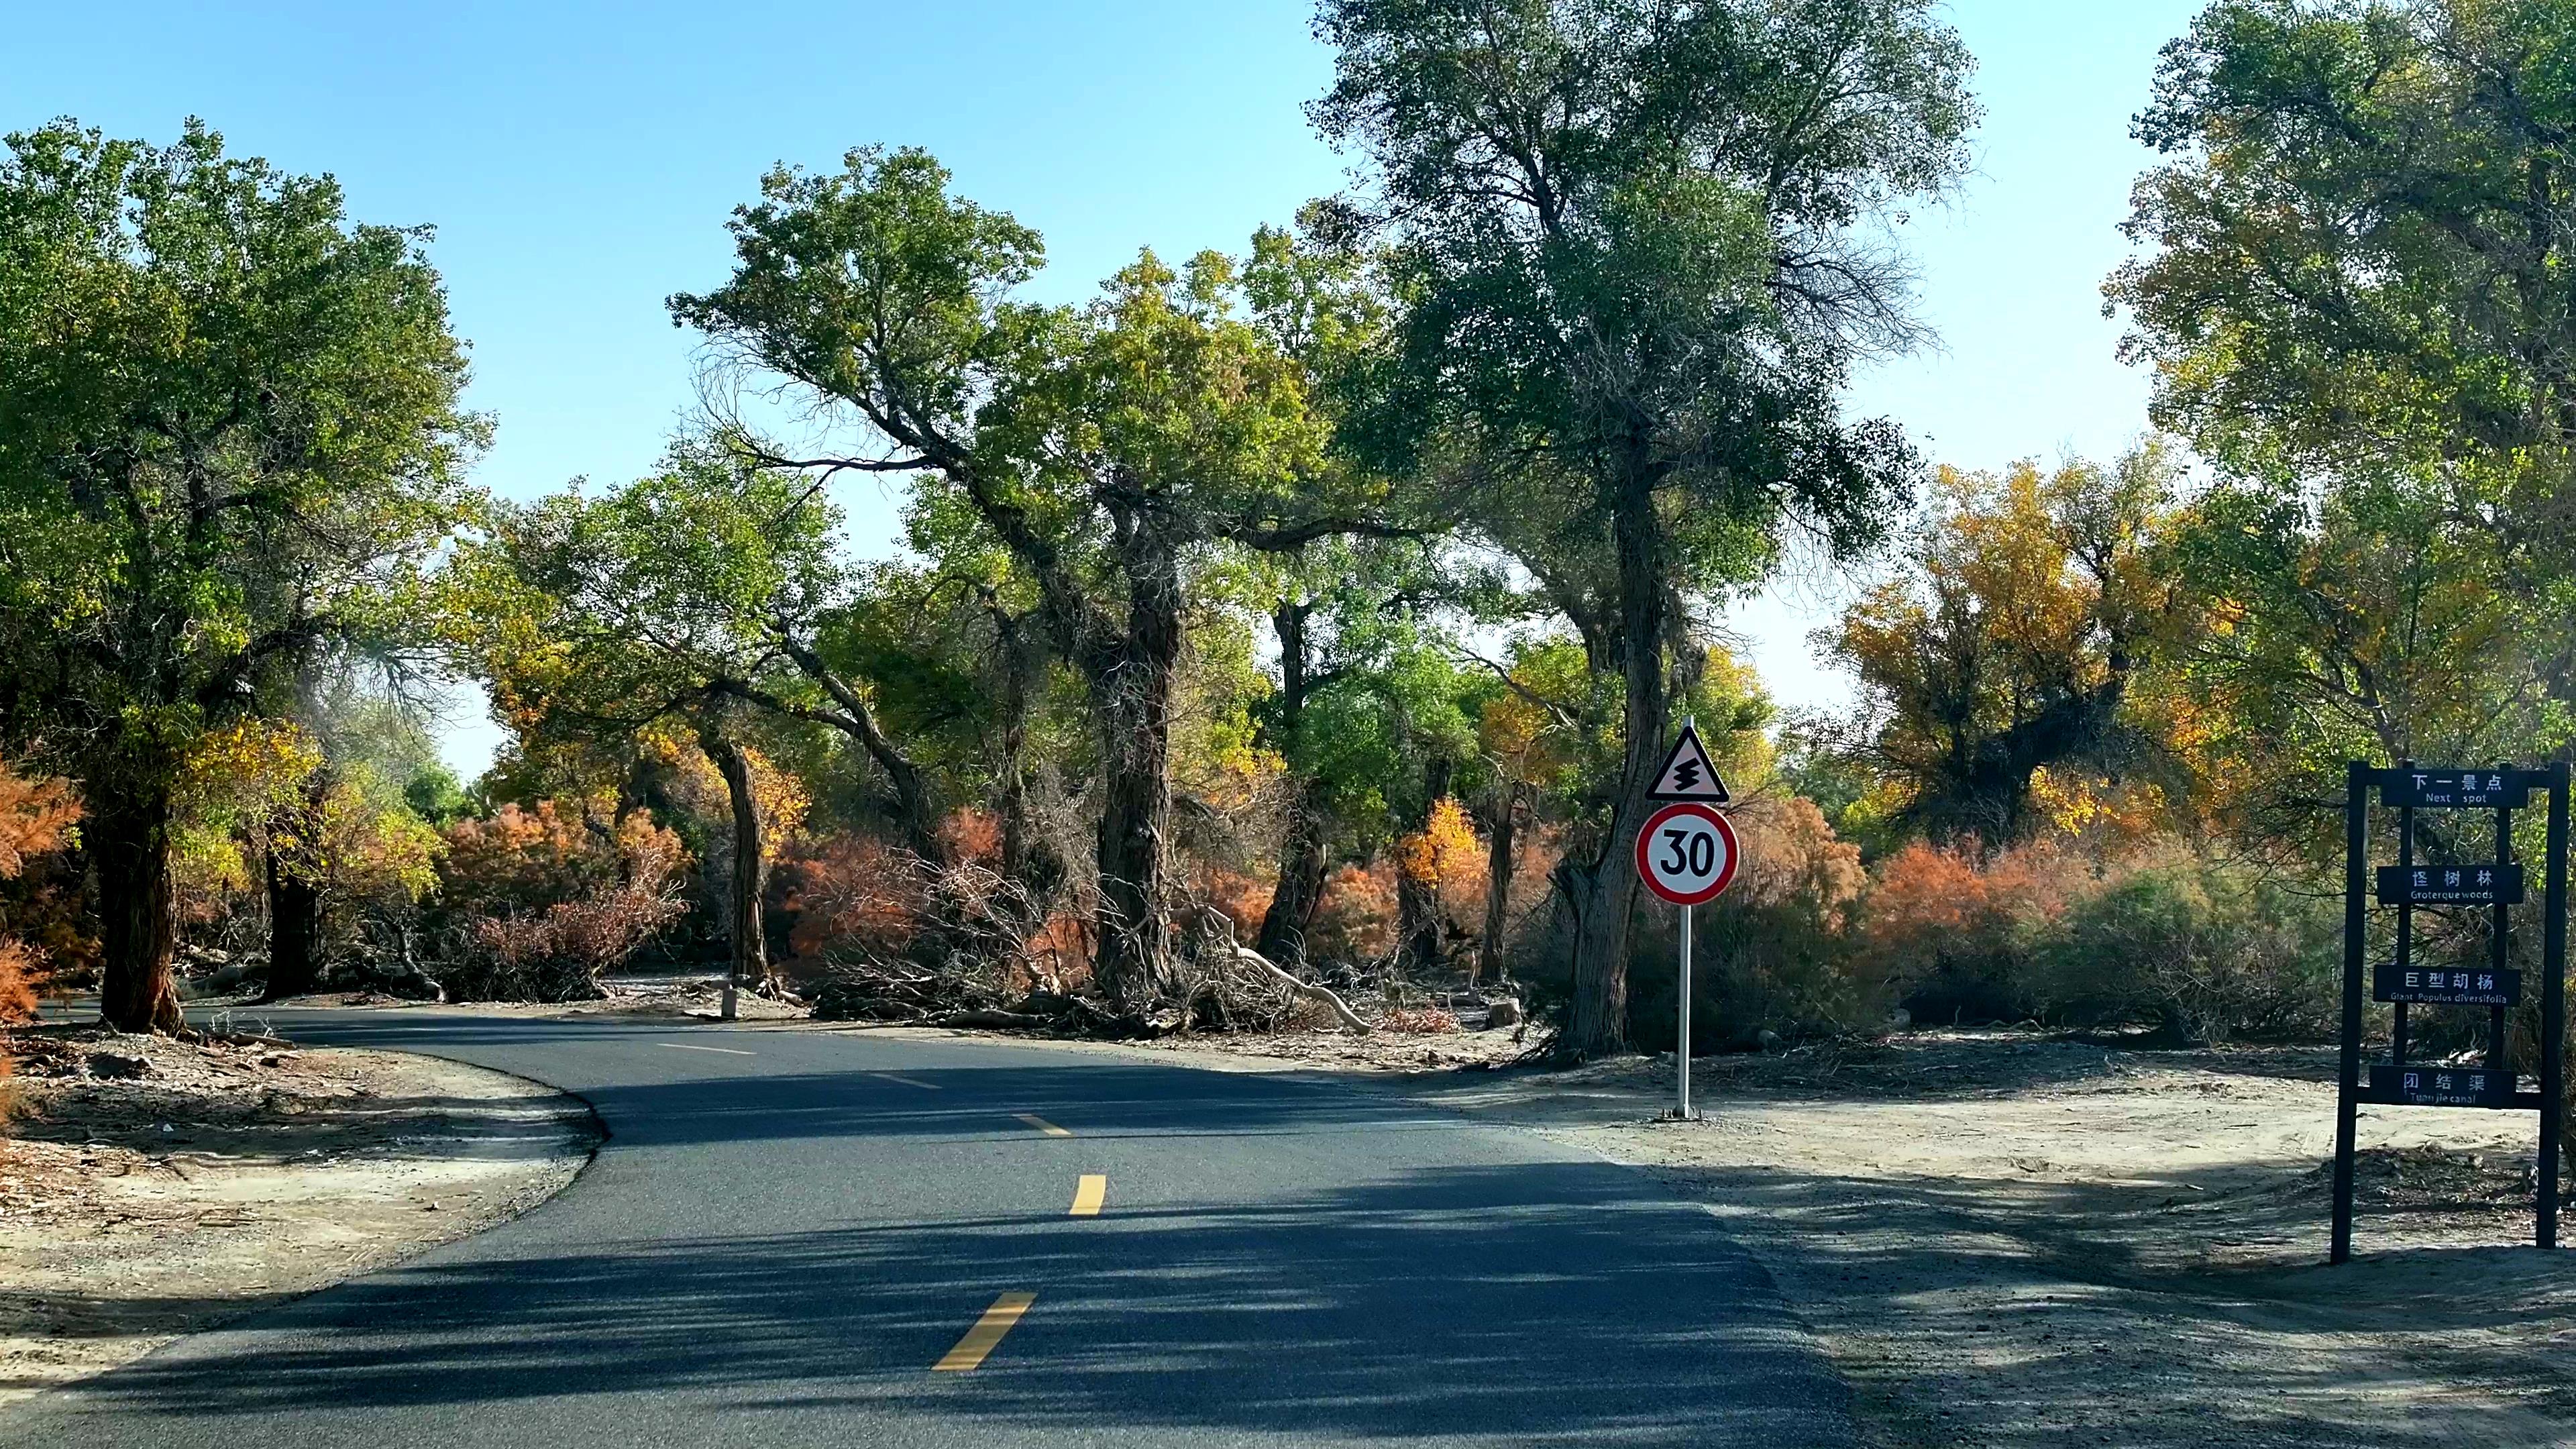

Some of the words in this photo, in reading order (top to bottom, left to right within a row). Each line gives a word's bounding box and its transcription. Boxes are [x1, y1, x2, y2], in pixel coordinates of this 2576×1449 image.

[2412, 774, 2502, 791] 下一景点
[2426, 793, 2451, 803] Next
[2463, 793, 2487, 804] spot
[1660, 828, 1715, 877] 30
[2412, 869, 2493, 887] 怪树林
[2405, 972, 2493, 990] 巨型胡杨
[2391, 992, 2413, 1000] Giant
[2418, 993, 2452, 1002] Populus
[2455, 994, 2507, 1004] diversifolia
[2404, 1072, 2485, 1091] 团结渠
[2450, 1094, 2476, 1104] canal
